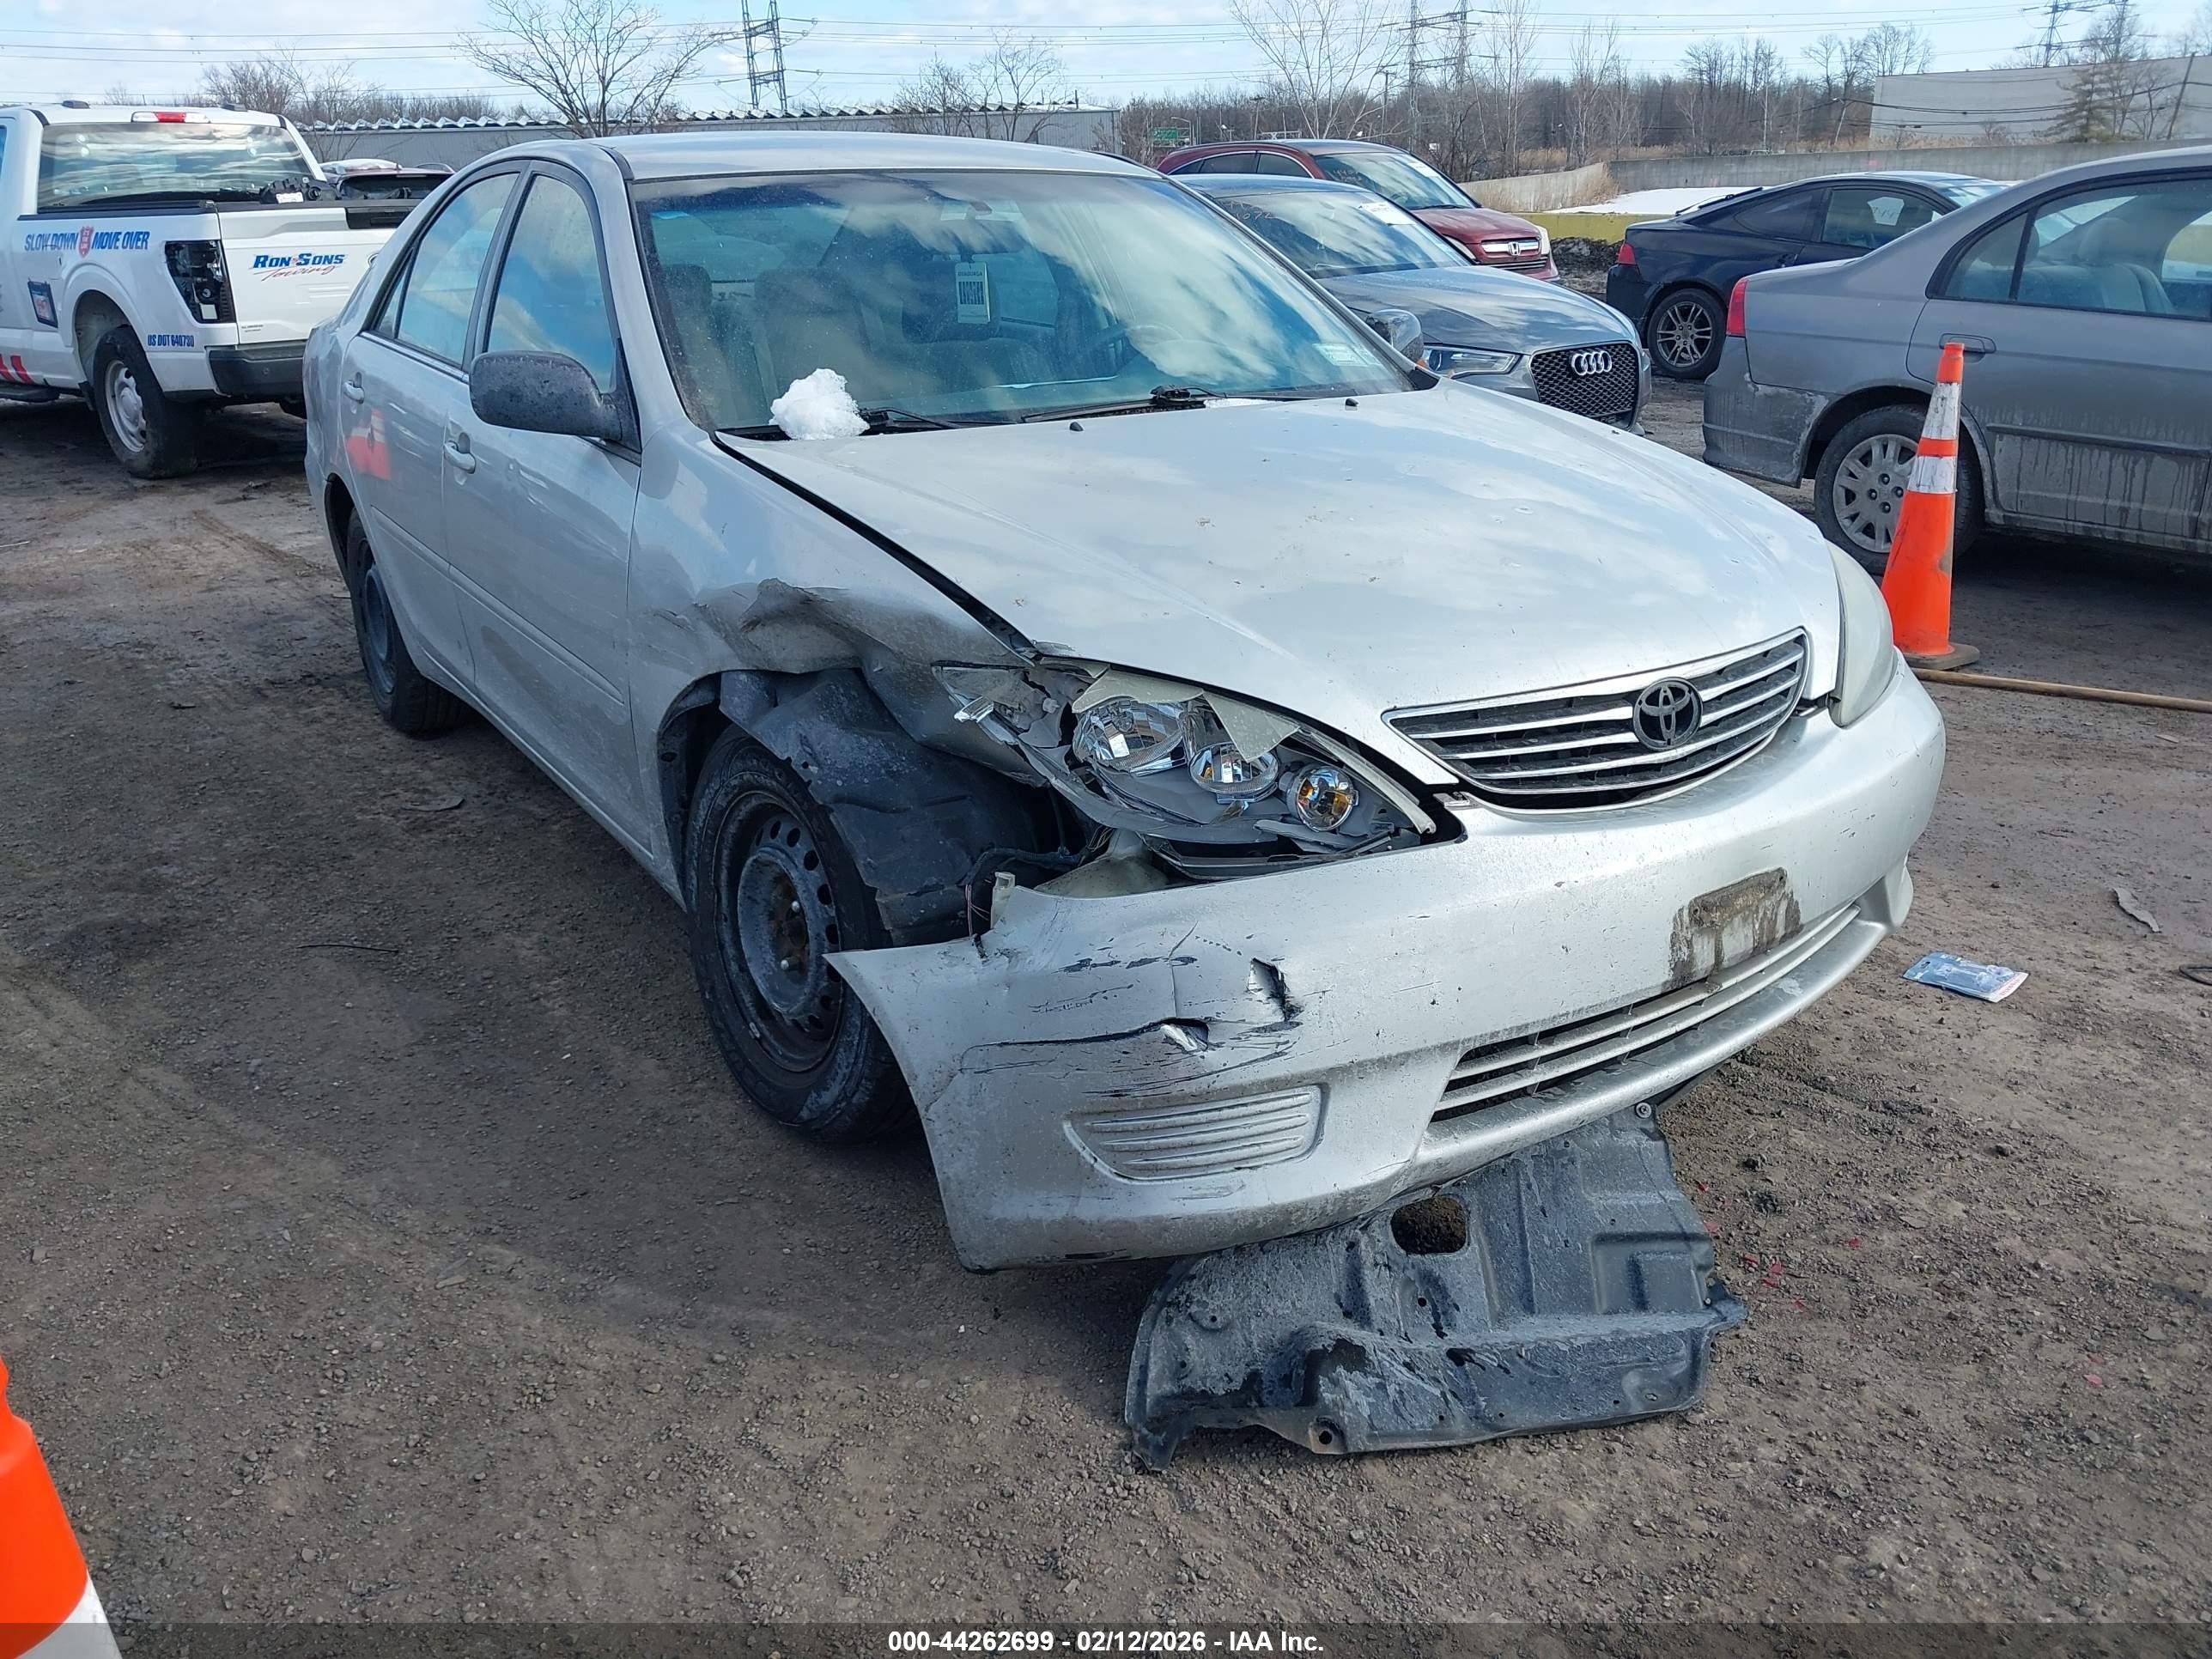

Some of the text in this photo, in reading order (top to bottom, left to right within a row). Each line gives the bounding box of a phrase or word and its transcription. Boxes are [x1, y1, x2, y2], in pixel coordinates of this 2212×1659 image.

[25, 233, 52, 252] SLOW
[52, 232, 79, 250] DOWN
[91, 231, 123, 250] MOVE
[121, 231, 151, 250] OVER
[147, 334, 157, 347] US
[157, 334, 170, 347] DOT
